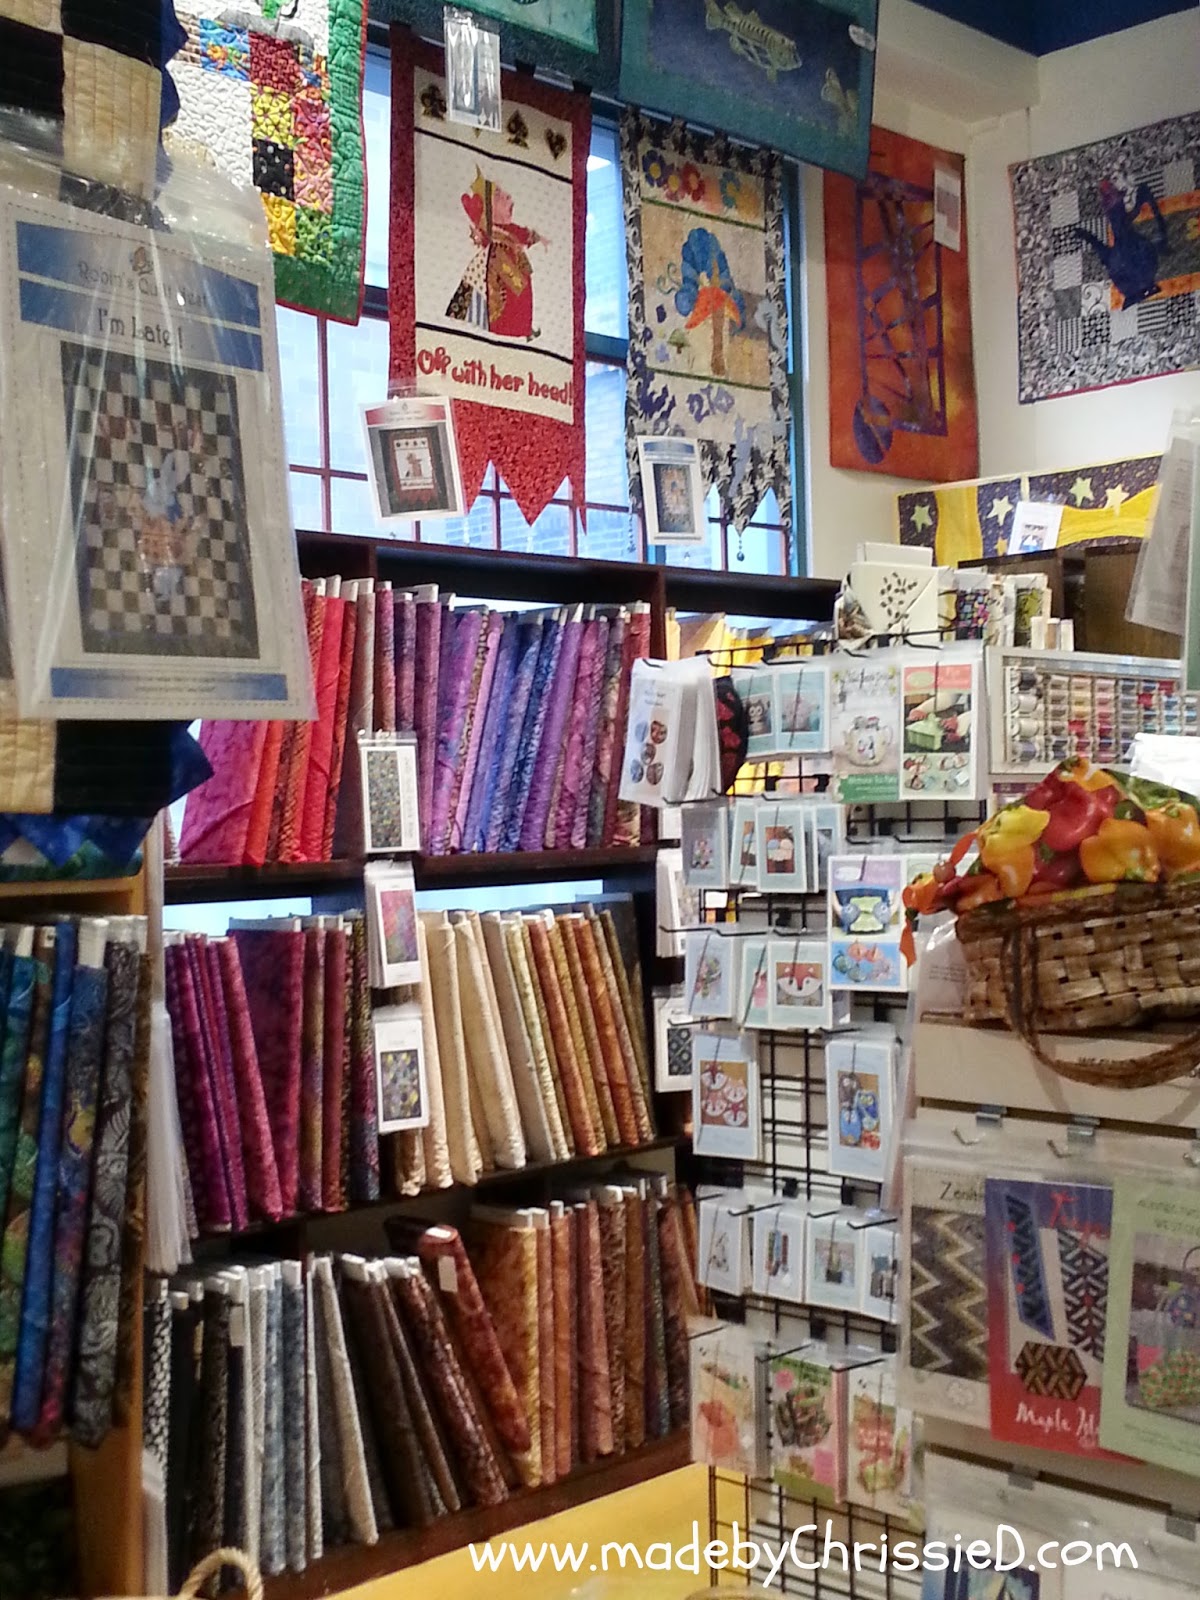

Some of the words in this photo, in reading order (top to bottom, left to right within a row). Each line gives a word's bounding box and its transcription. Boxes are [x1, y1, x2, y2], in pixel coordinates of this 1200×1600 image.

[98, 307, 125, 336] I'm
[451, 359, 487, 387] with
[490, 364, 524, 392] her
[528, 371, 574, 407] head!
[1014, 1401, 1071, 1434] Maple
